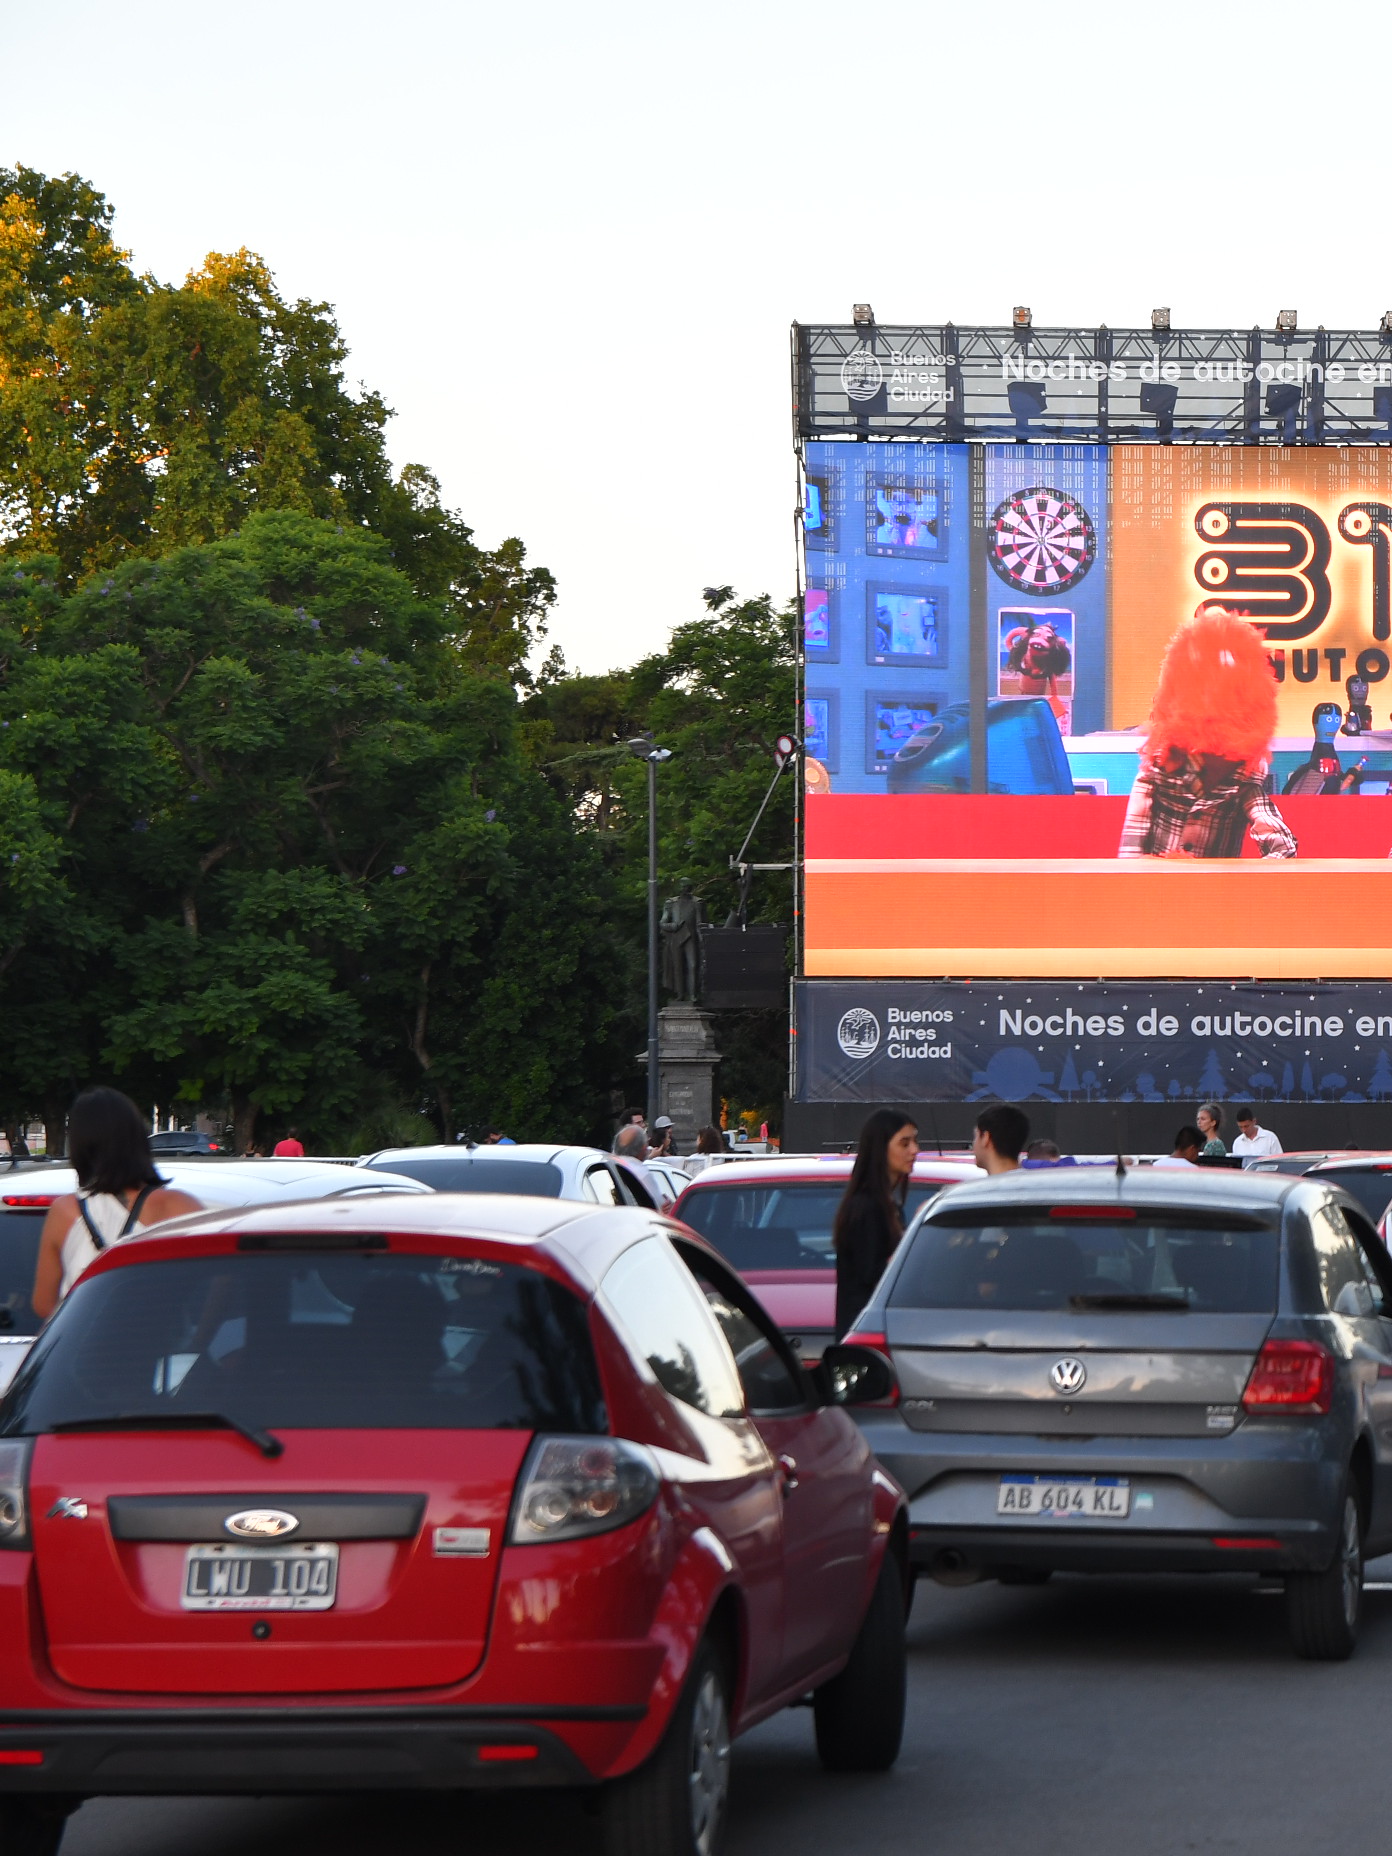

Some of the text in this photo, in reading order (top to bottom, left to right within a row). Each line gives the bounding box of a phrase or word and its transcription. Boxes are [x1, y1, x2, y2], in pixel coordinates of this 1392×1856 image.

[890, 351, 956, 366] Buenos
[1002, 353, 1127, 382] Noches
[1139, 353, 1181, 382] de
[1193, 356, 1346, 383] autocine
[890, 369, 939, 384] Aires
[890, 386, 955, 402] Ciudad
[887, 1007, 954, 1023] Buenos
[1000, 1008, 1125, 1036] Noches
[1137, 1008, 1179, 1036] de
[1190, 1009, 1344, 1037] autocine
[887, 1026, 937, 1041] Aires
[887, 1042, 952, 1059] Ciudad
[1003, 1487, 1121, 1512] AB 604 KL
[187, 1559, 331, 1597] LWU 104
